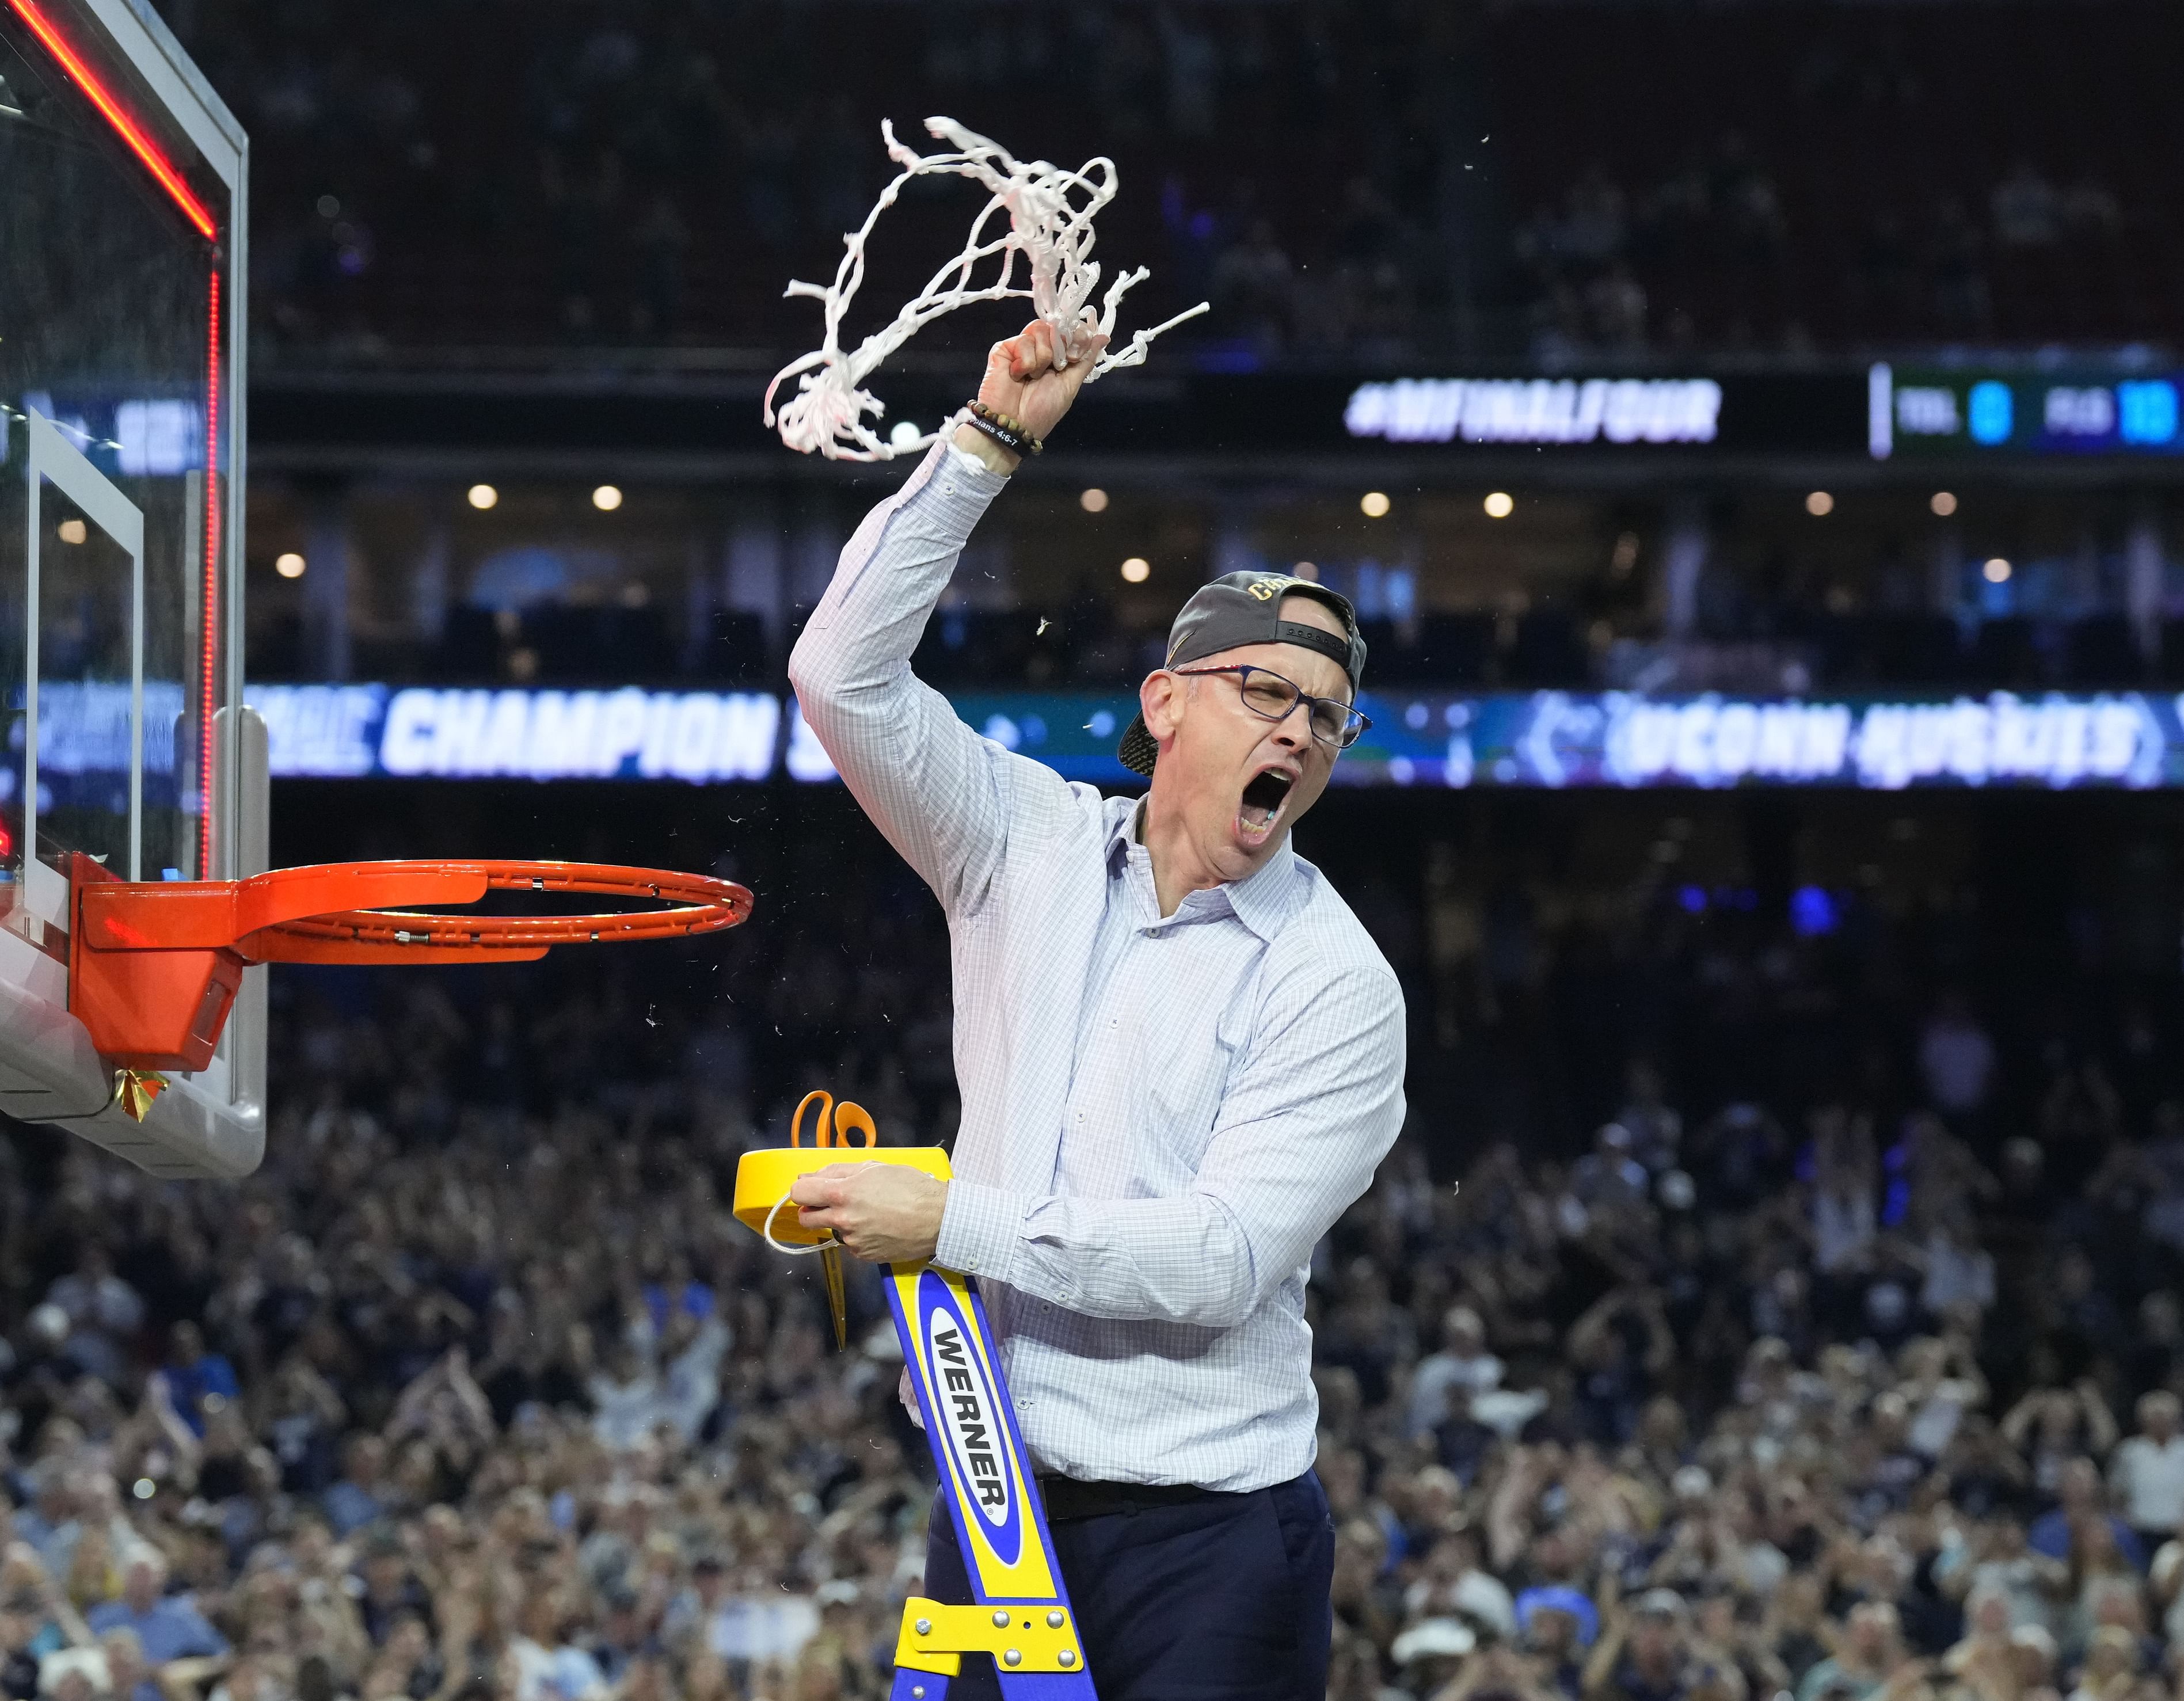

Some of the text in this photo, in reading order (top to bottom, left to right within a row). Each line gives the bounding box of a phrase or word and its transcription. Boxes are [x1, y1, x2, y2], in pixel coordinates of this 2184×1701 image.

[997, 431, 1018, 446] 4:6-7
[1629, 702, 1849, 775] UCONN
[934, 1329, 1005, 1505] WERNER
